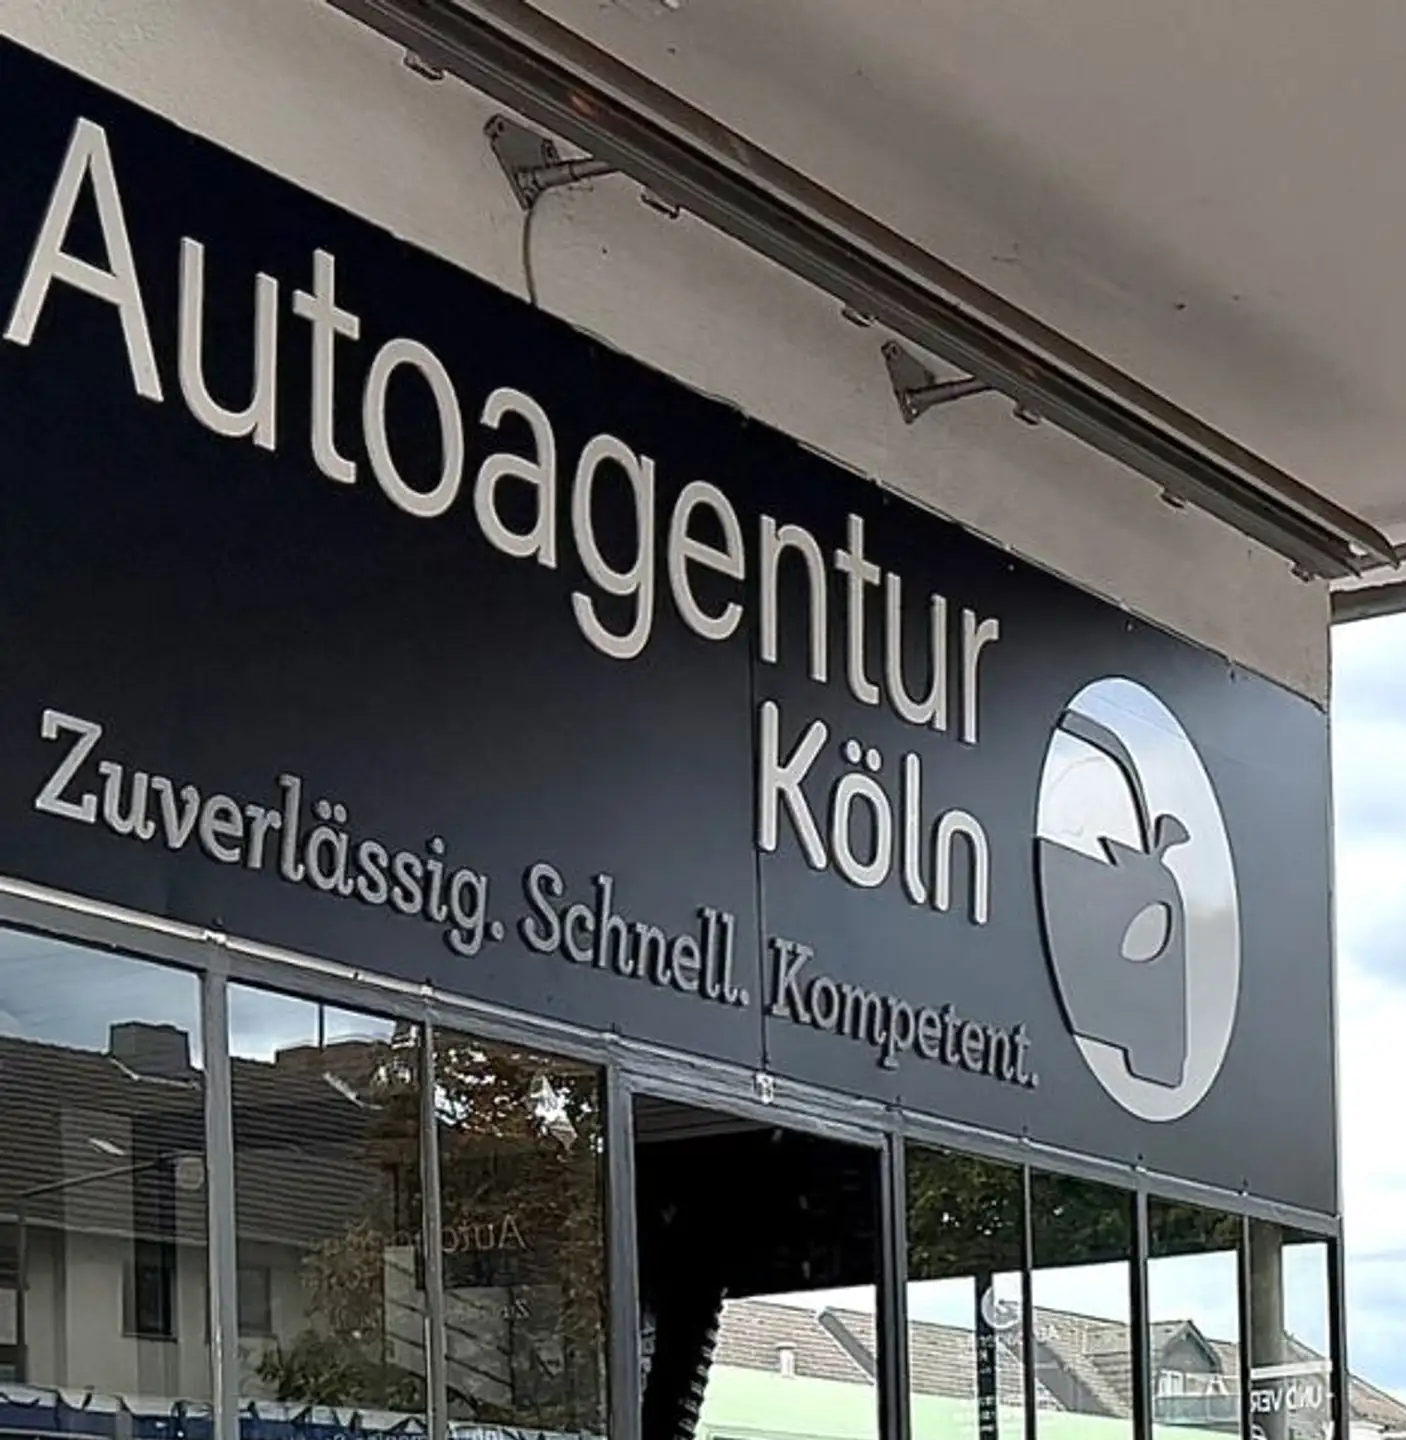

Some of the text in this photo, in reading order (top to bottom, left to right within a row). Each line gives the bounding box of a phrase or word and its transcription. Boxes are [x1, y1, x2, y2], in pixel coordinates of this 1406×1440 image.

[3, 116, 999, 745] Autoagentur
[34, 707, 1041, 1088] Zuverlässig. Schnell. Kompetent.
[757, 699, 990, 925] Köln
